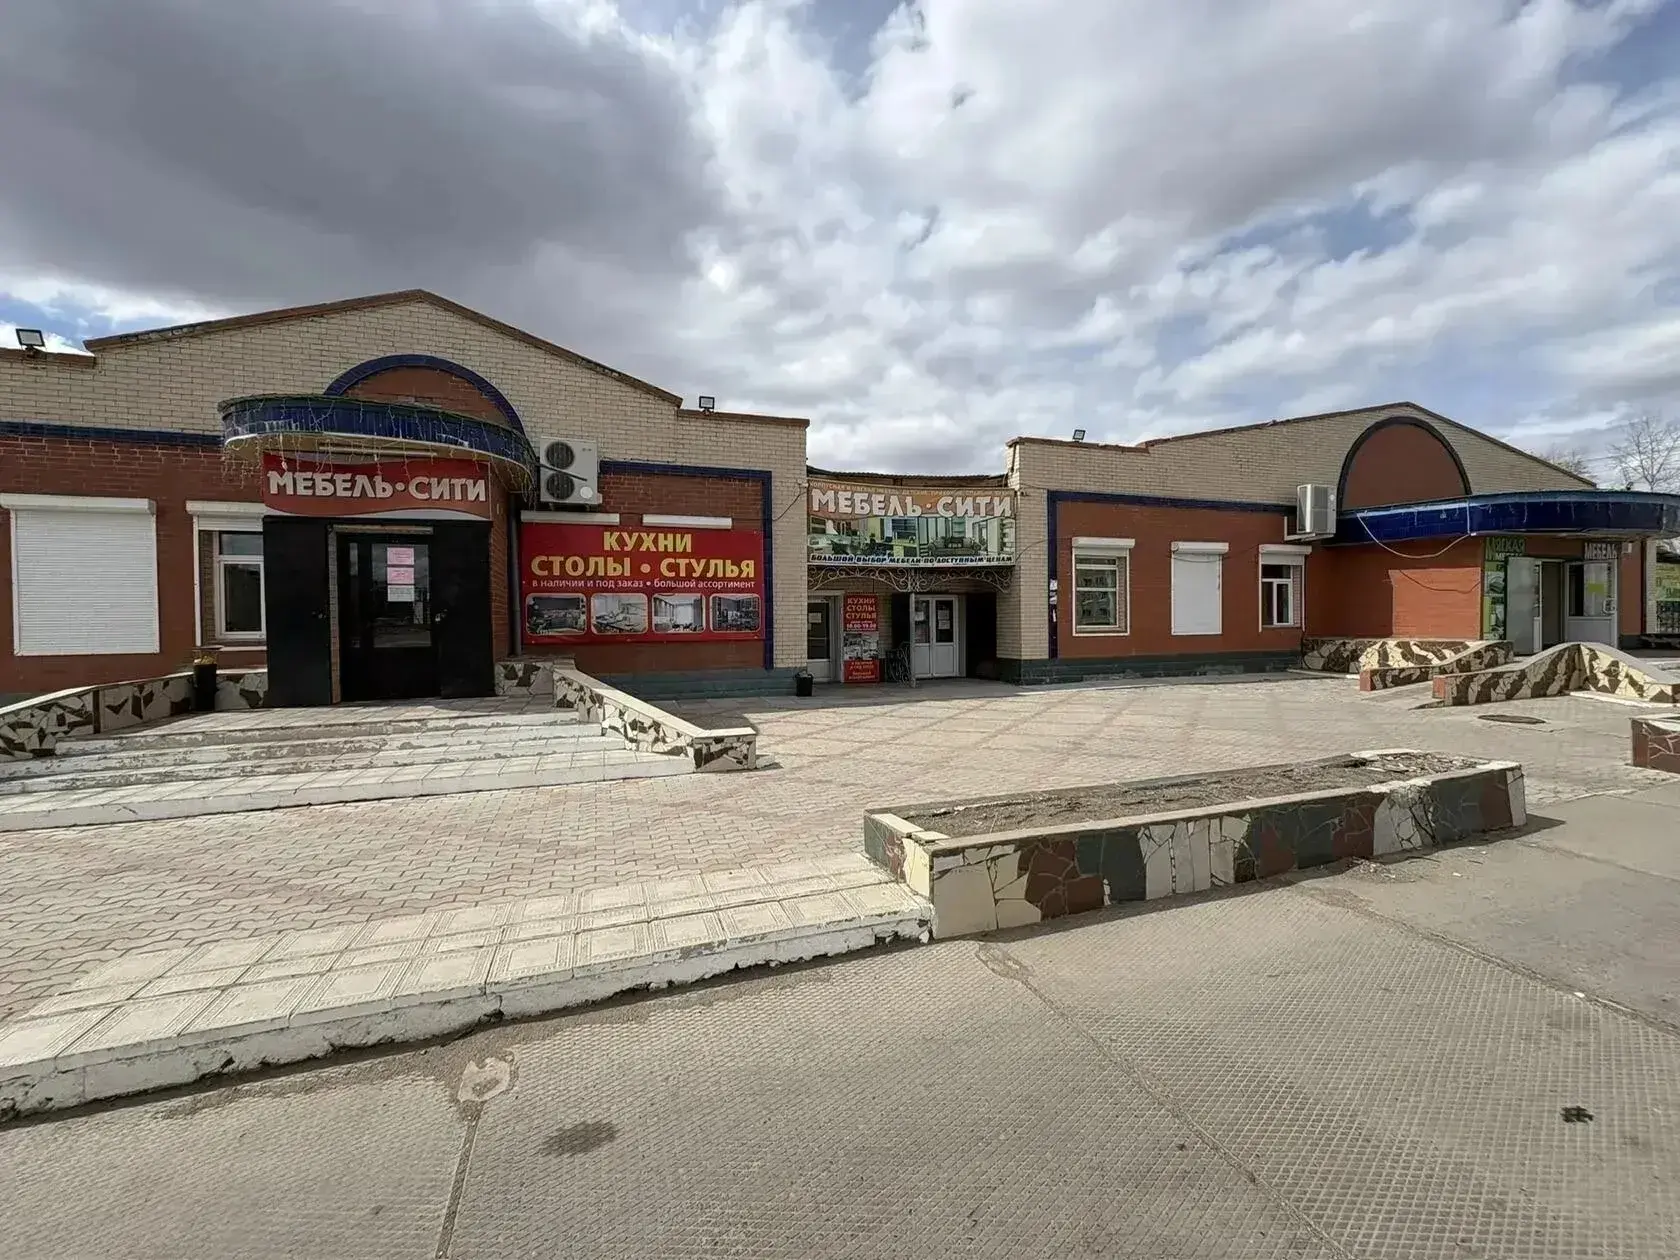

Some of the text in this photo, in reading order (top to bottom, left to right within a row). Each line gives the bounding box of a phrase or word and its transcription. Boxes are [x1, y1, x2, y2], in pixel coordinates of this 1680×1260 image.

[267, 470, 486, 501] МЕБЕЛЬ СИТИ
[811, 489, 1012, 518] МЕБЕЛЬ СИТИ
[603, 531, 692, 552] КУХНИ
[531, 556, 755, 578] СТОЛЫ СТУЛЬЯ
[810, 554, 853, 563] БОЛЬШОЙ
[856, 555, 887, 563] ВЫБОР
[541, 580, 585, 588] наличии
[597, 581, 615, 589] под
[654, 579, 696, 589] большой
[698, 581, 756, 590] ассортимент
